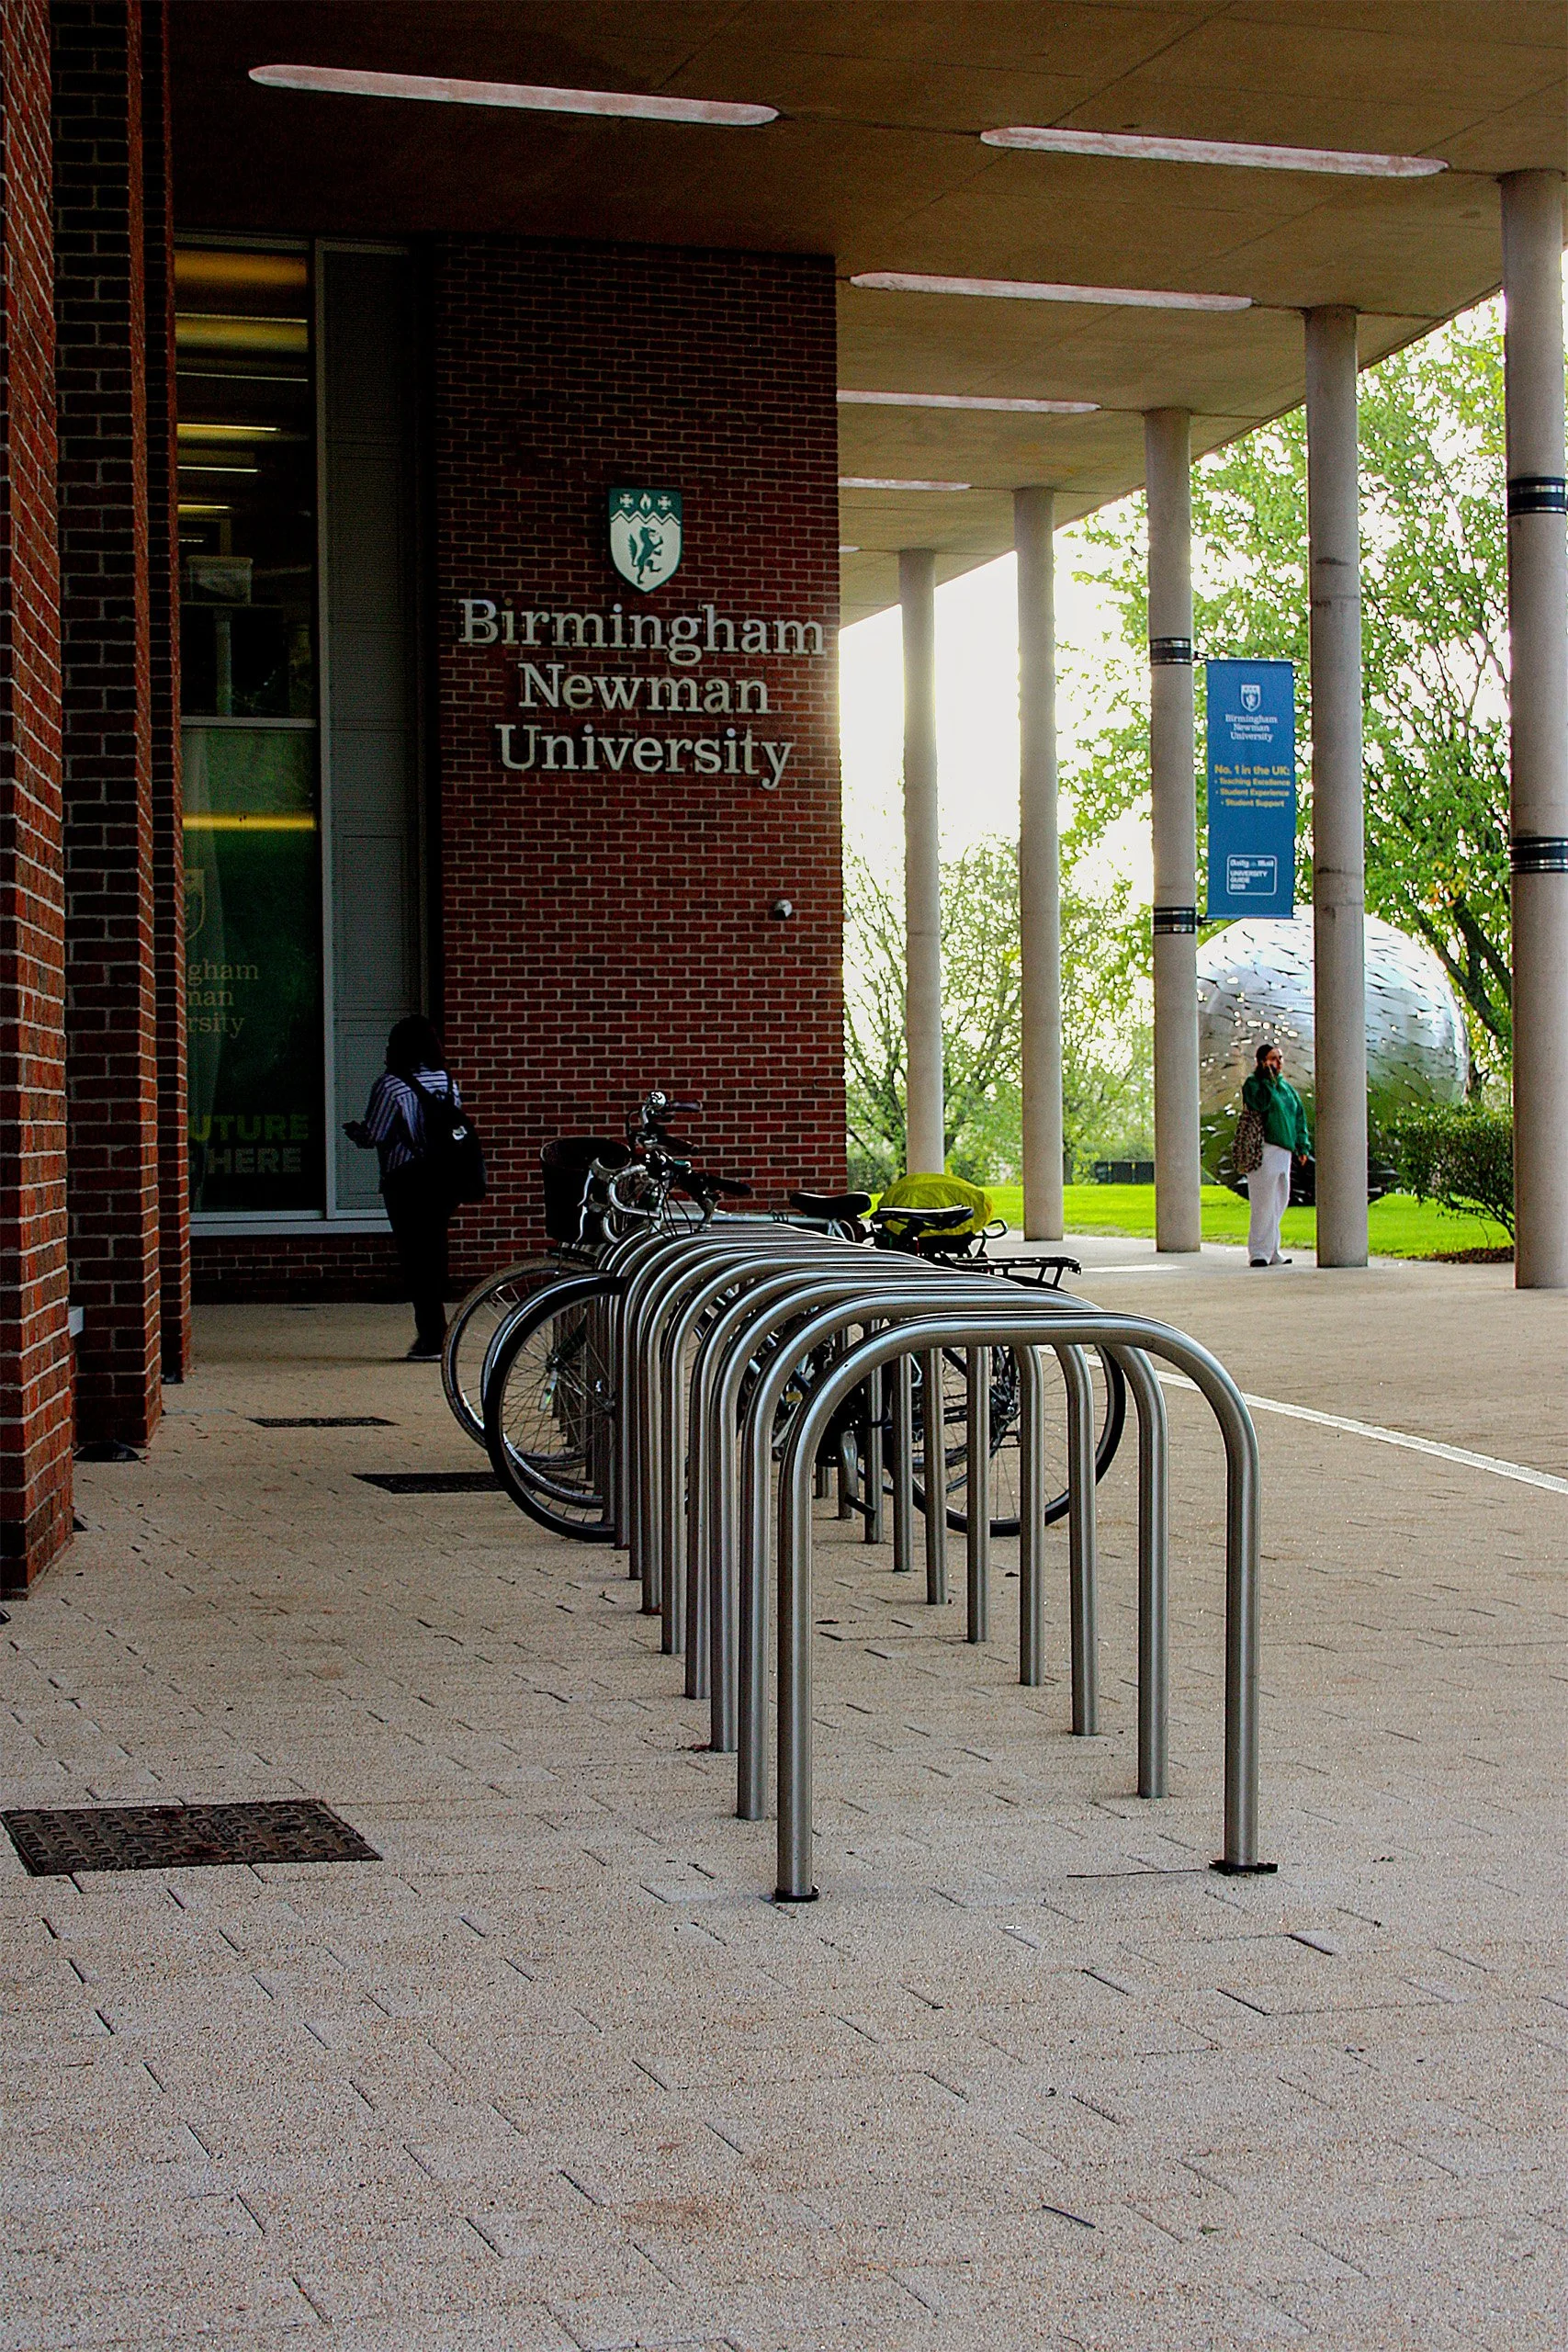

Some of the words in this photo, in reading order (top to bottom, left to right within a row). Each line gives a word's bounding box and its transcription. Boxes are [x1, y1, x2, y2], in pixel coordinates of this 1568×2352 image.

[458, 599, 826, 666] Birmingham
[518, 663, 772, 714] Newman
[1224, 714, 1278, 724] Birmingham
[1233, 723, 1270, 732] Newman
[1230, 731, 1273, 742] University
[494, 724, 794, 790] University
[1214, 764, 1232, 775] No.
[1235, 764, 1240, 775] 1
[1241, 764, 1251, 775] in
[1253, 766, 1270, 775] the
[1220, 777, 1251, 786] Teaching
[1253, 778, 1291, 786] Excellence
[1250, 788, 1290, 797] Experience
[1225, 798, 1254, 807] Student
[1255, 799, 1284, 808] Support
[186, 990, 235, 1007] man
[186, 1012, 245, 1039] rsity
[188, 1114, 309, 1141] UTURE
[207, 1148, 301, 1174] HERE
